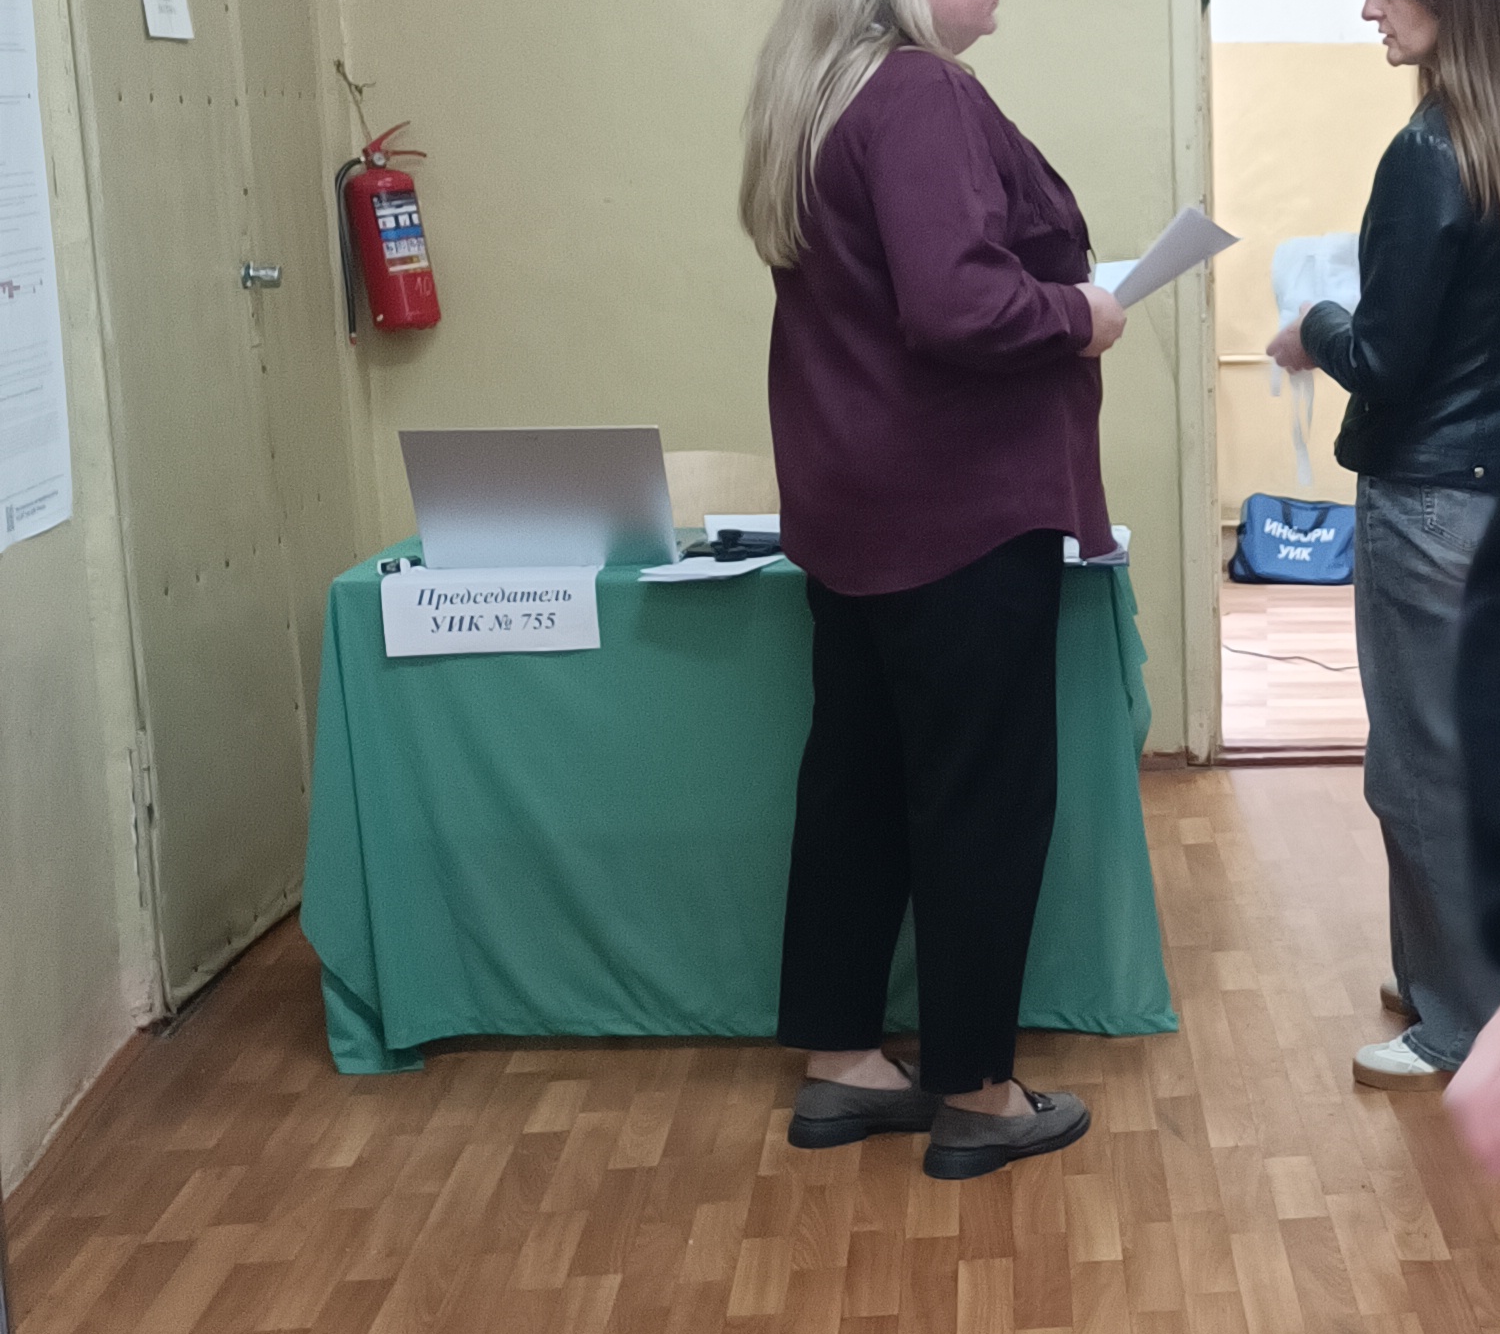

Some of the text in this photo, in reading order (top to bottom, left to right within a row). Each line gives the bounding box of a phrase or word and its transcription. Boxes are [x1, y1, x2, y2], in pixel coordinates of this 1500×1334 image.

[1277, 544, 1312, 561] УИК
[416, 586, 573, 611] Председатель
[430, 612, 557, 634] УИК № 755
